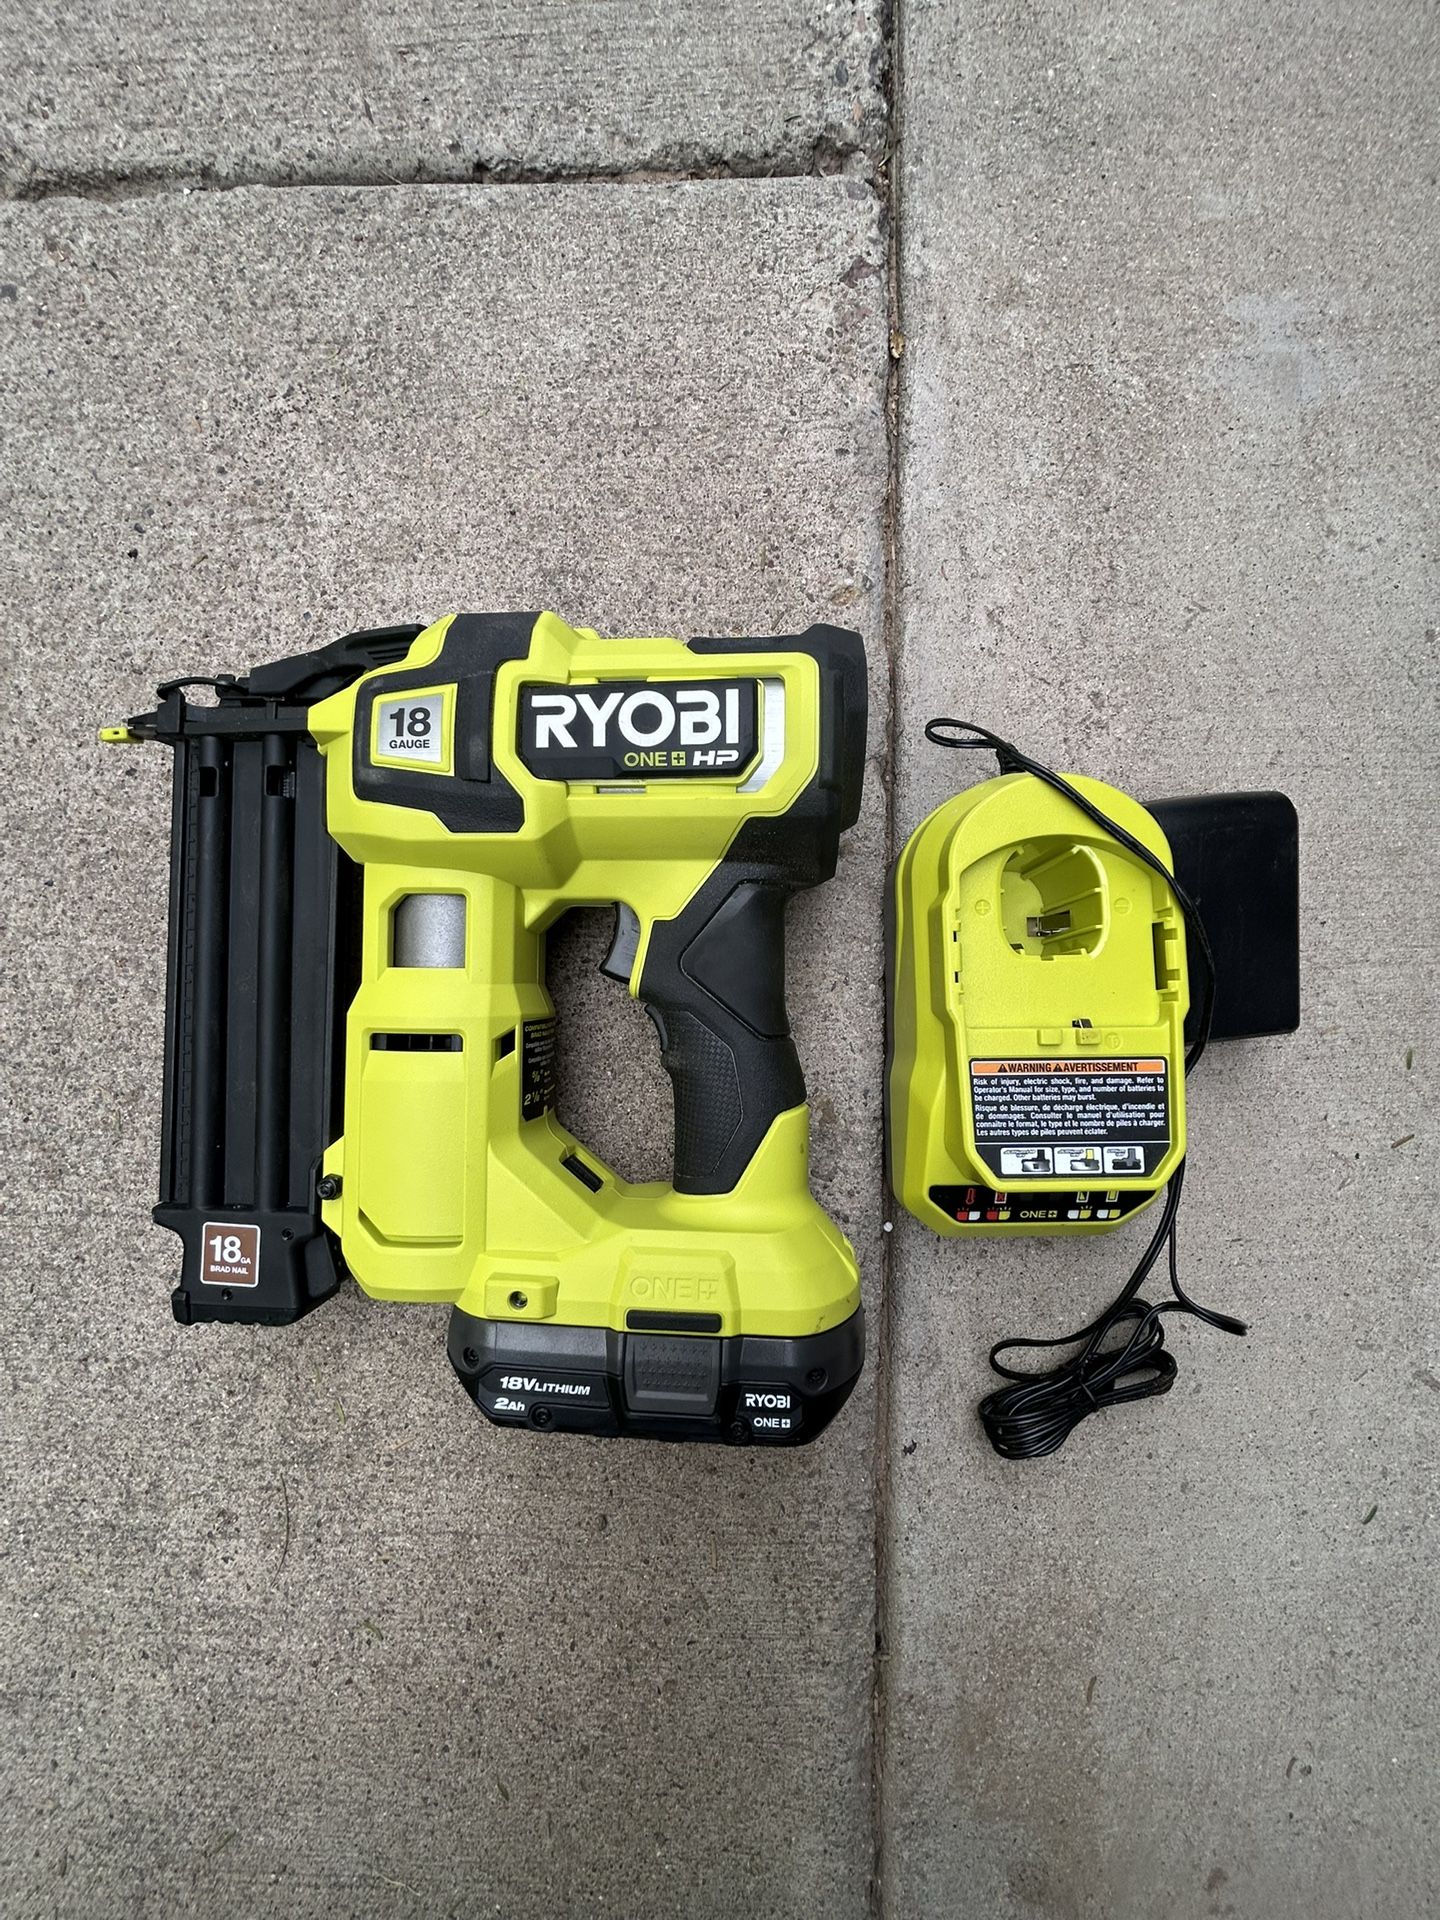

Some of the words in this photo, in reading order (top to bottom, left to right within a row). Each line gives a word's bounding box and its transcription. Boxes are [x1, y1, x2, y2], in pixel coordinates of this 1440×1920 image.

[389, 707, 431, 738] 18
[531, 689, 740, 749] RYOBI
[389, 738, 430, 750] GAUGE
[693, 750, 740, 766] HP
[1008, 1064, 1051, 1072] WARNING
[1064, 1062, 1138, 1072] AVERTISSEMENT
[210, 1235, 241, 1263] 18
[210, 1265, 231, 1273] BRAD
[232, 1266, 248, 1275] NAIL
[745, 1393, 791, 1410] RYOBI
